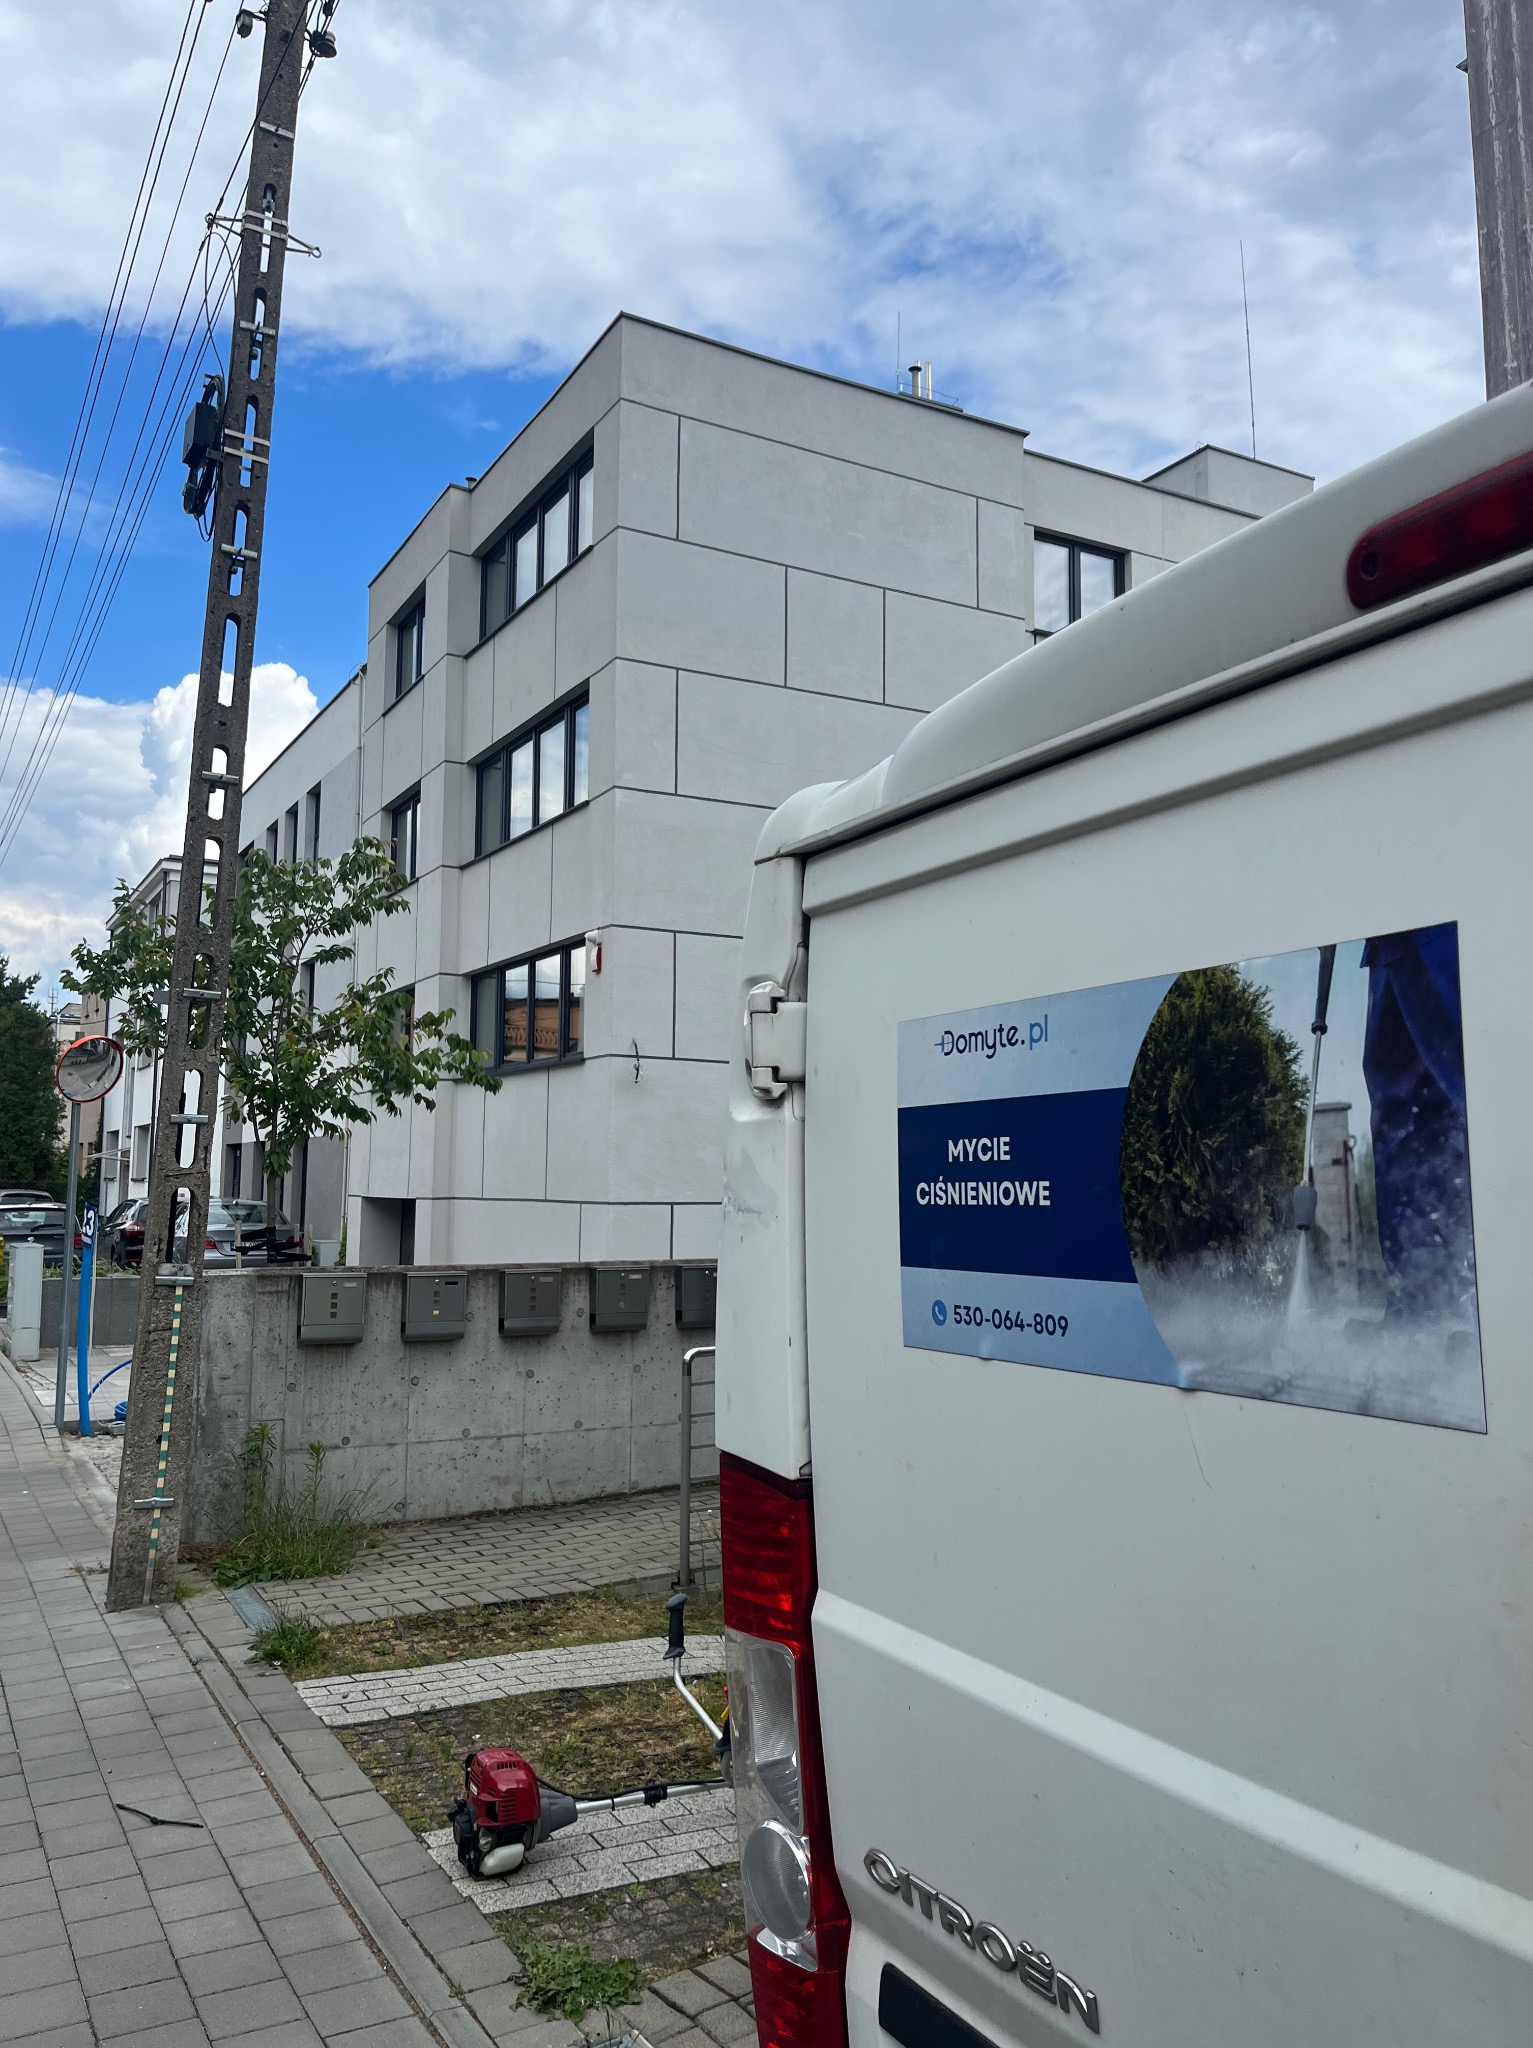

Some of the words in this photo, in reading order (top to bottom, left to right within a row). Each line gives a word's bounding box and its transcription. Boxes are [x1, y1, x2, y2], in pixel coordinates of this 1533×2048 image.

[940, 1014, 1048, 1059] Domyte.pl
[948, 1137, 1010, 1162] MYCIE
[916, 1176, 1050, 1206] CIŚNIENIOWE
[953, 1304, 1068, 1337] 530-064-809
[864, 1848, 1100, 2034] CITROËN
